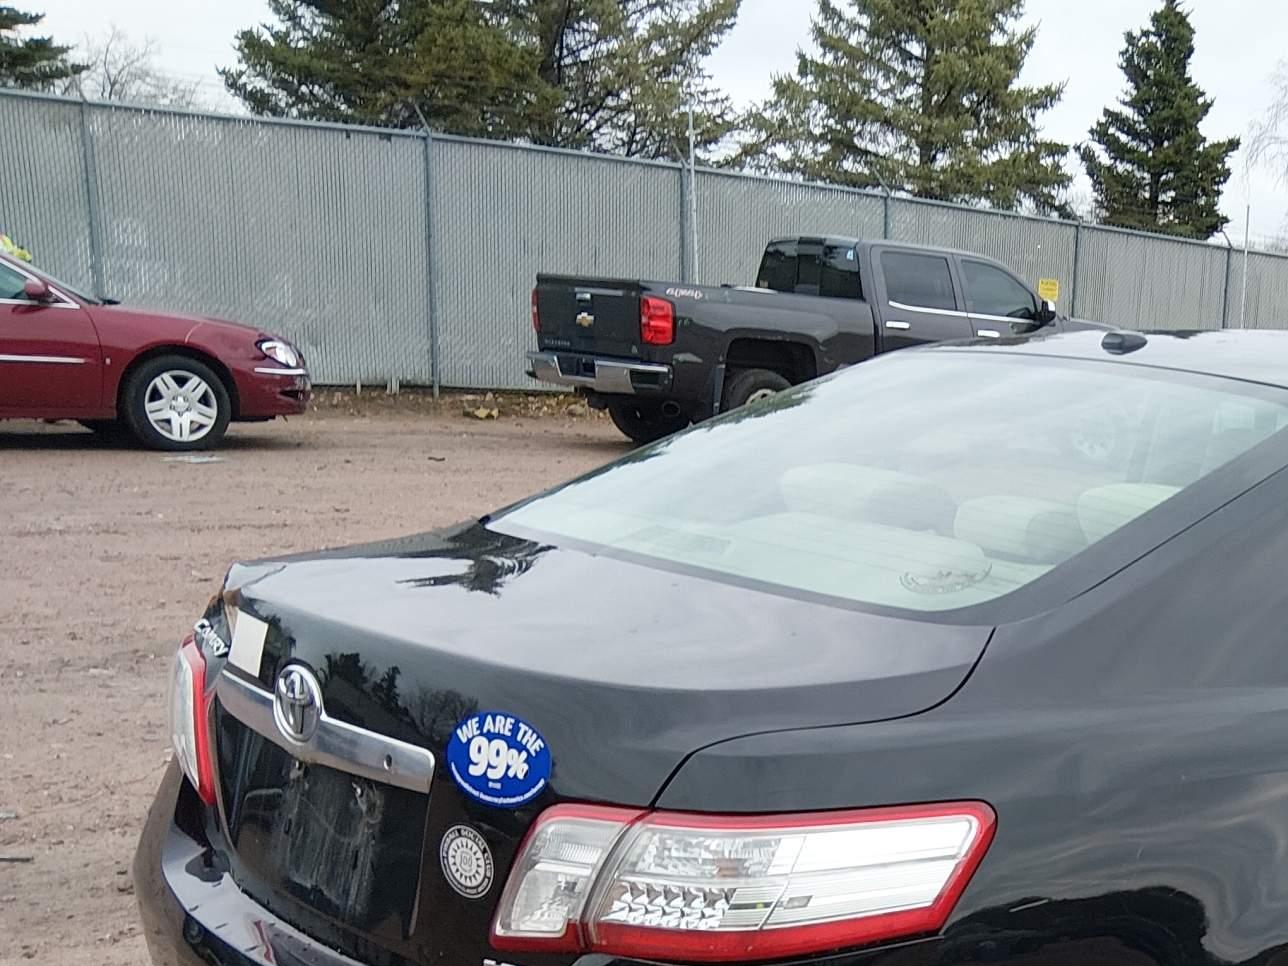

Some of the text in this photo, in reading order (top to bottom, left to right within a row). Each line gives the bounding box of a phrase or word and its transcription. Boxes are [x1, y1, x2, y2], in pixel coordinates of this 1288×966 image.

[194, 618, 229, 656] CAMRY
[456, 714, 545, 757] WE ARE THE
[468, 735, 529, 780] 99%
